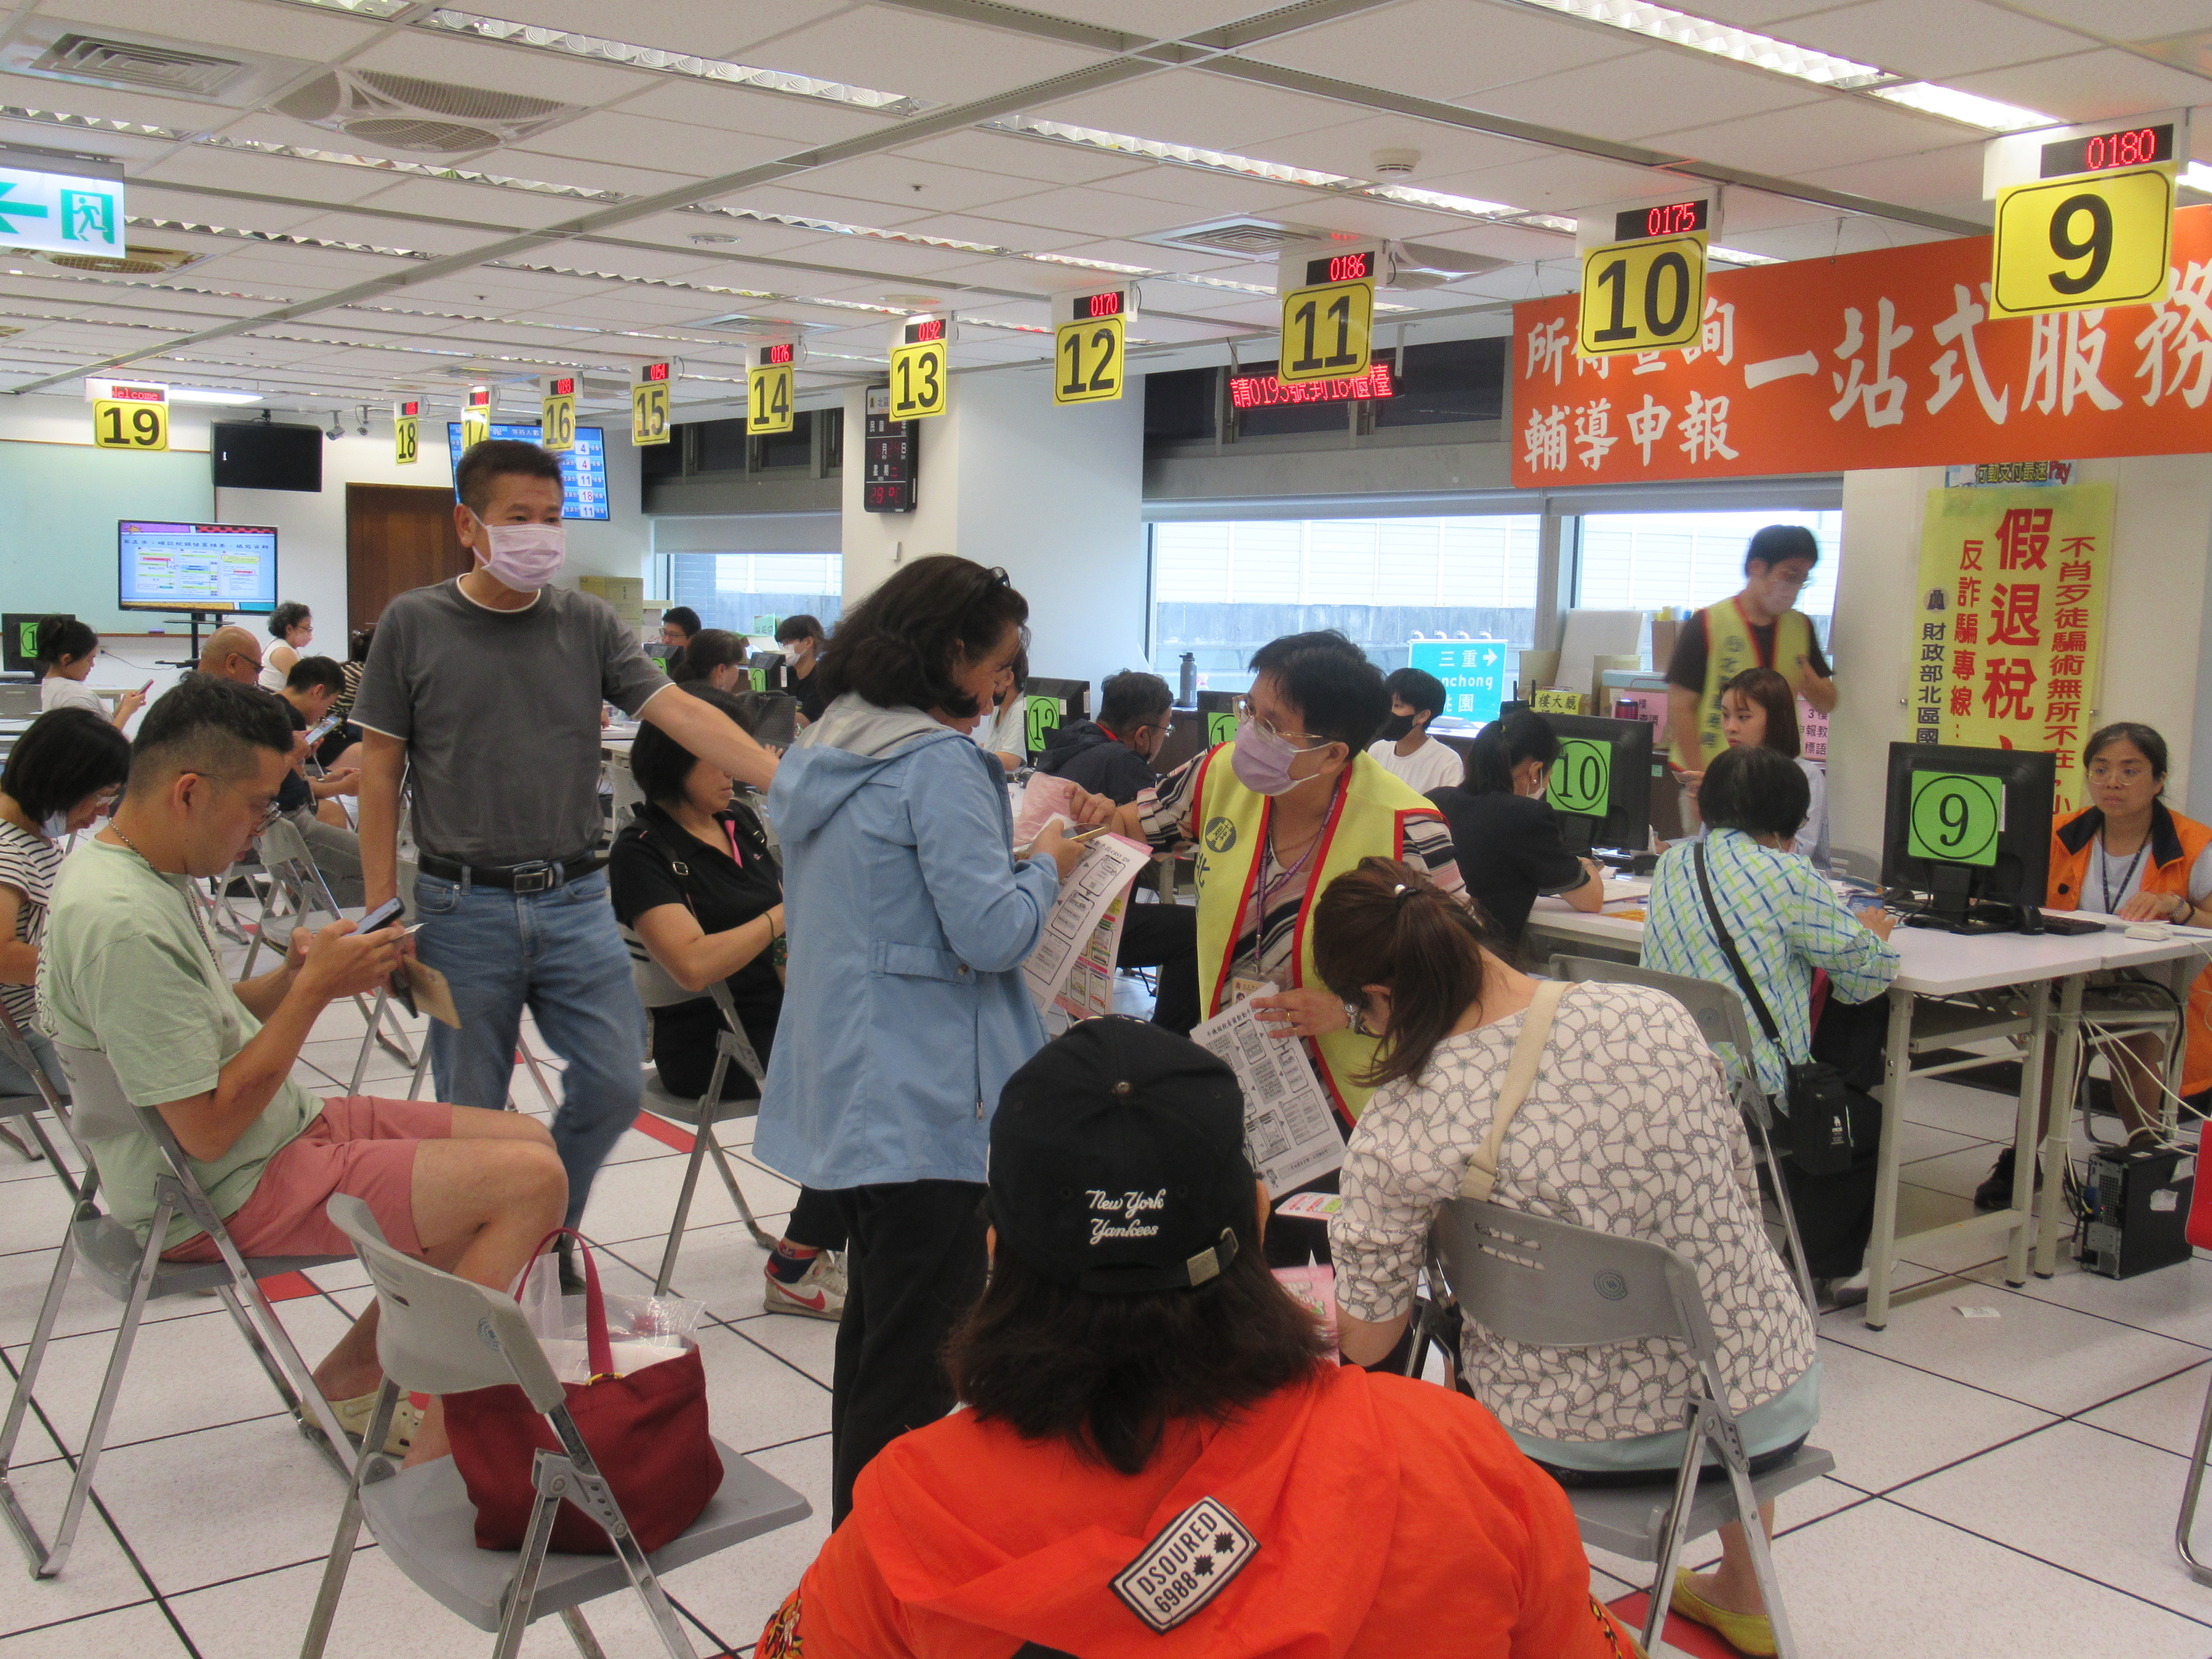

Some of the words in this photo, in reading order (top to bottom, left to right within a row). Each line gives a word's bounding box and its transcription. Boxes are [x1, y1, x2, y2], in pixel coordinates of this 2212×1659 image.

[2086, 128, 2157, 170] 0180
[1647, 202, 1696, 236] 0175
[2049, 194, 2113, 294] 9
[1330, 253, 1366, 282] 0186
[1090, 293, 1119, 317] 0170
[1593, 251, 1690, 343] 10
[918, 321, 942, 341] 0192
[1292, 295, 1358, 372] 11
[651, 364, 667, 380] 0154
[771, 345, 791, 363] 0176
[1062, 329, 1115, 394] 12
[558, 379, 573, 394] 0193
[754, 373, 789, 425] 14
[896, 352, 939, 410] 13
[103, 407, 159, 445] 19
[546, 402, 571, 445] 16
[637, 390, 665, 437] 15
[1524, 390, 1739, 473] 輔導申報
[399, 422, 415, 459] 18
[1982, 508, 2053, 750] 假退稅
[1439, 649, 1478, 667] 三重
[1557, 754, 1600, 801] 10
[1939, 794, 1968, 847] 9
[1086, 1190, 1123, 1210] New
[1124, 1188, 1166, 1219] York
[1089, 1218, 1159, 1245] Yankees
[1136, 1511, 1218, 1596] DSOURED
[1154, 1571, 1198, 1614] 6988
